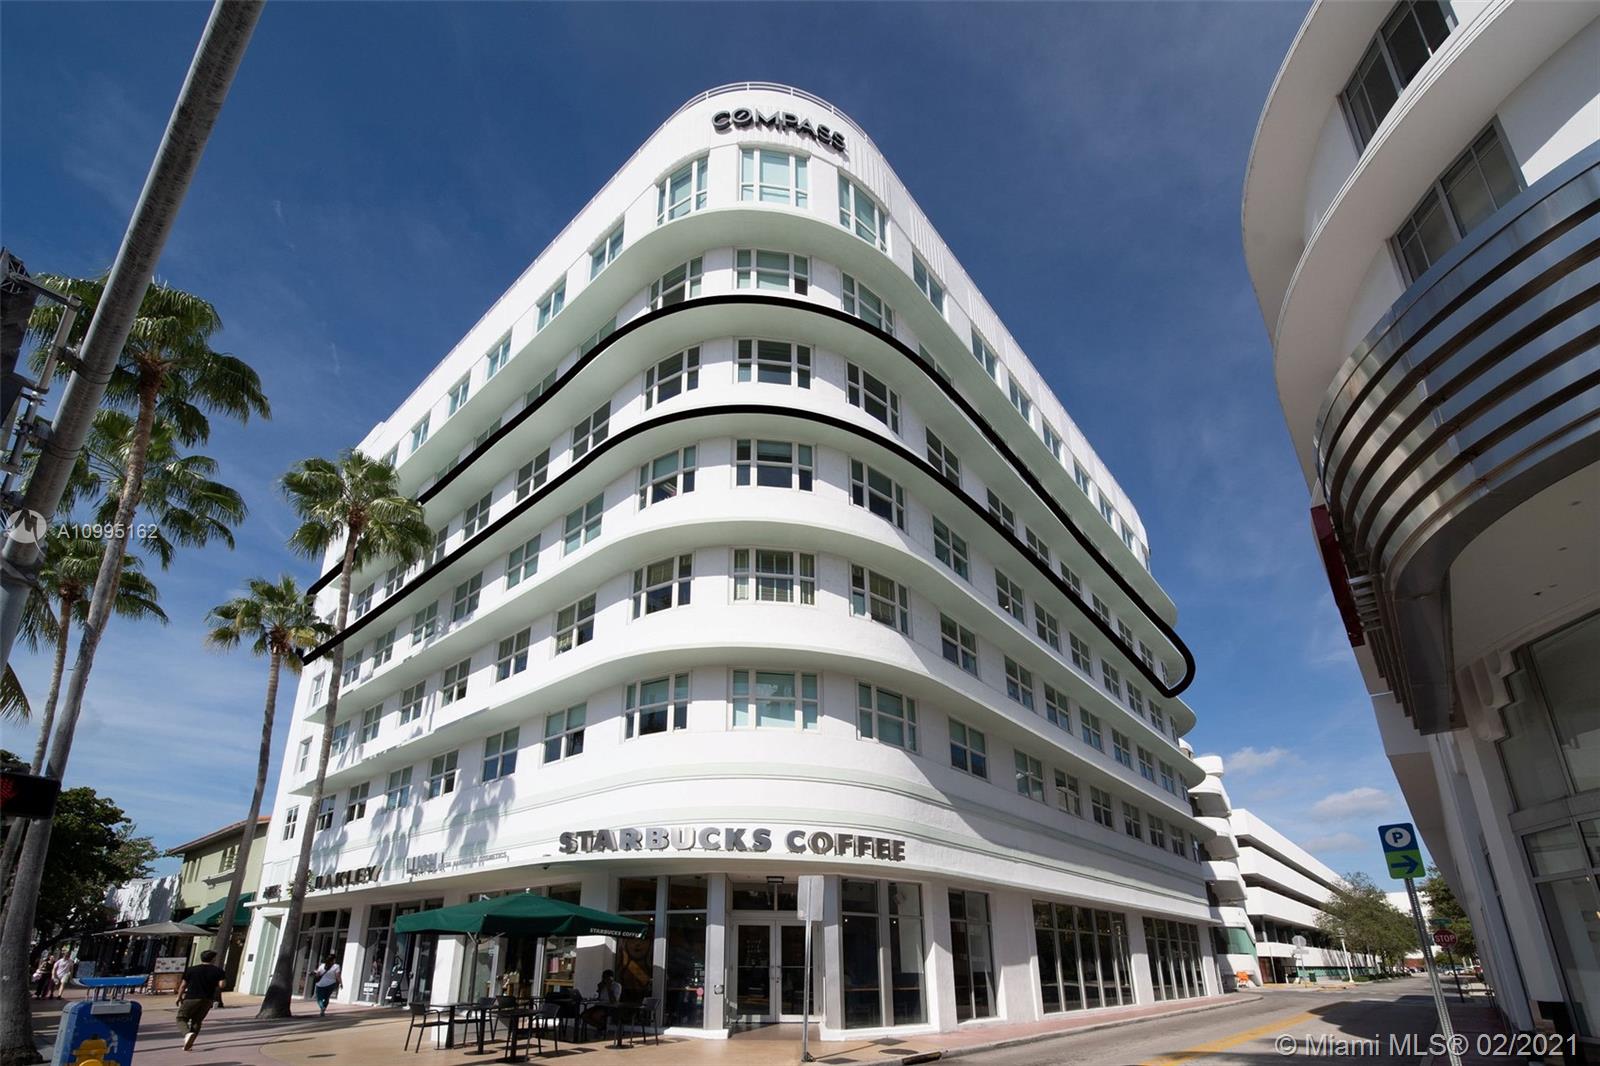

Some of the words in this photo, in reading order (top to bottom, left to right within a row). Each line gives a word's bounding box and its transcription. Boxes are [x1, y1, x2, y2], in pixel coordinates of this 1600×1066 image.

[711, 107, 846, 152] COMPASS
[558, 826, 772, 854] STARBUCKS
[785, 829, 906, 862] COFFEE
[589, 927, 621, 936] STARBUCKS
[1434, 934, 1456, 943] STOP
